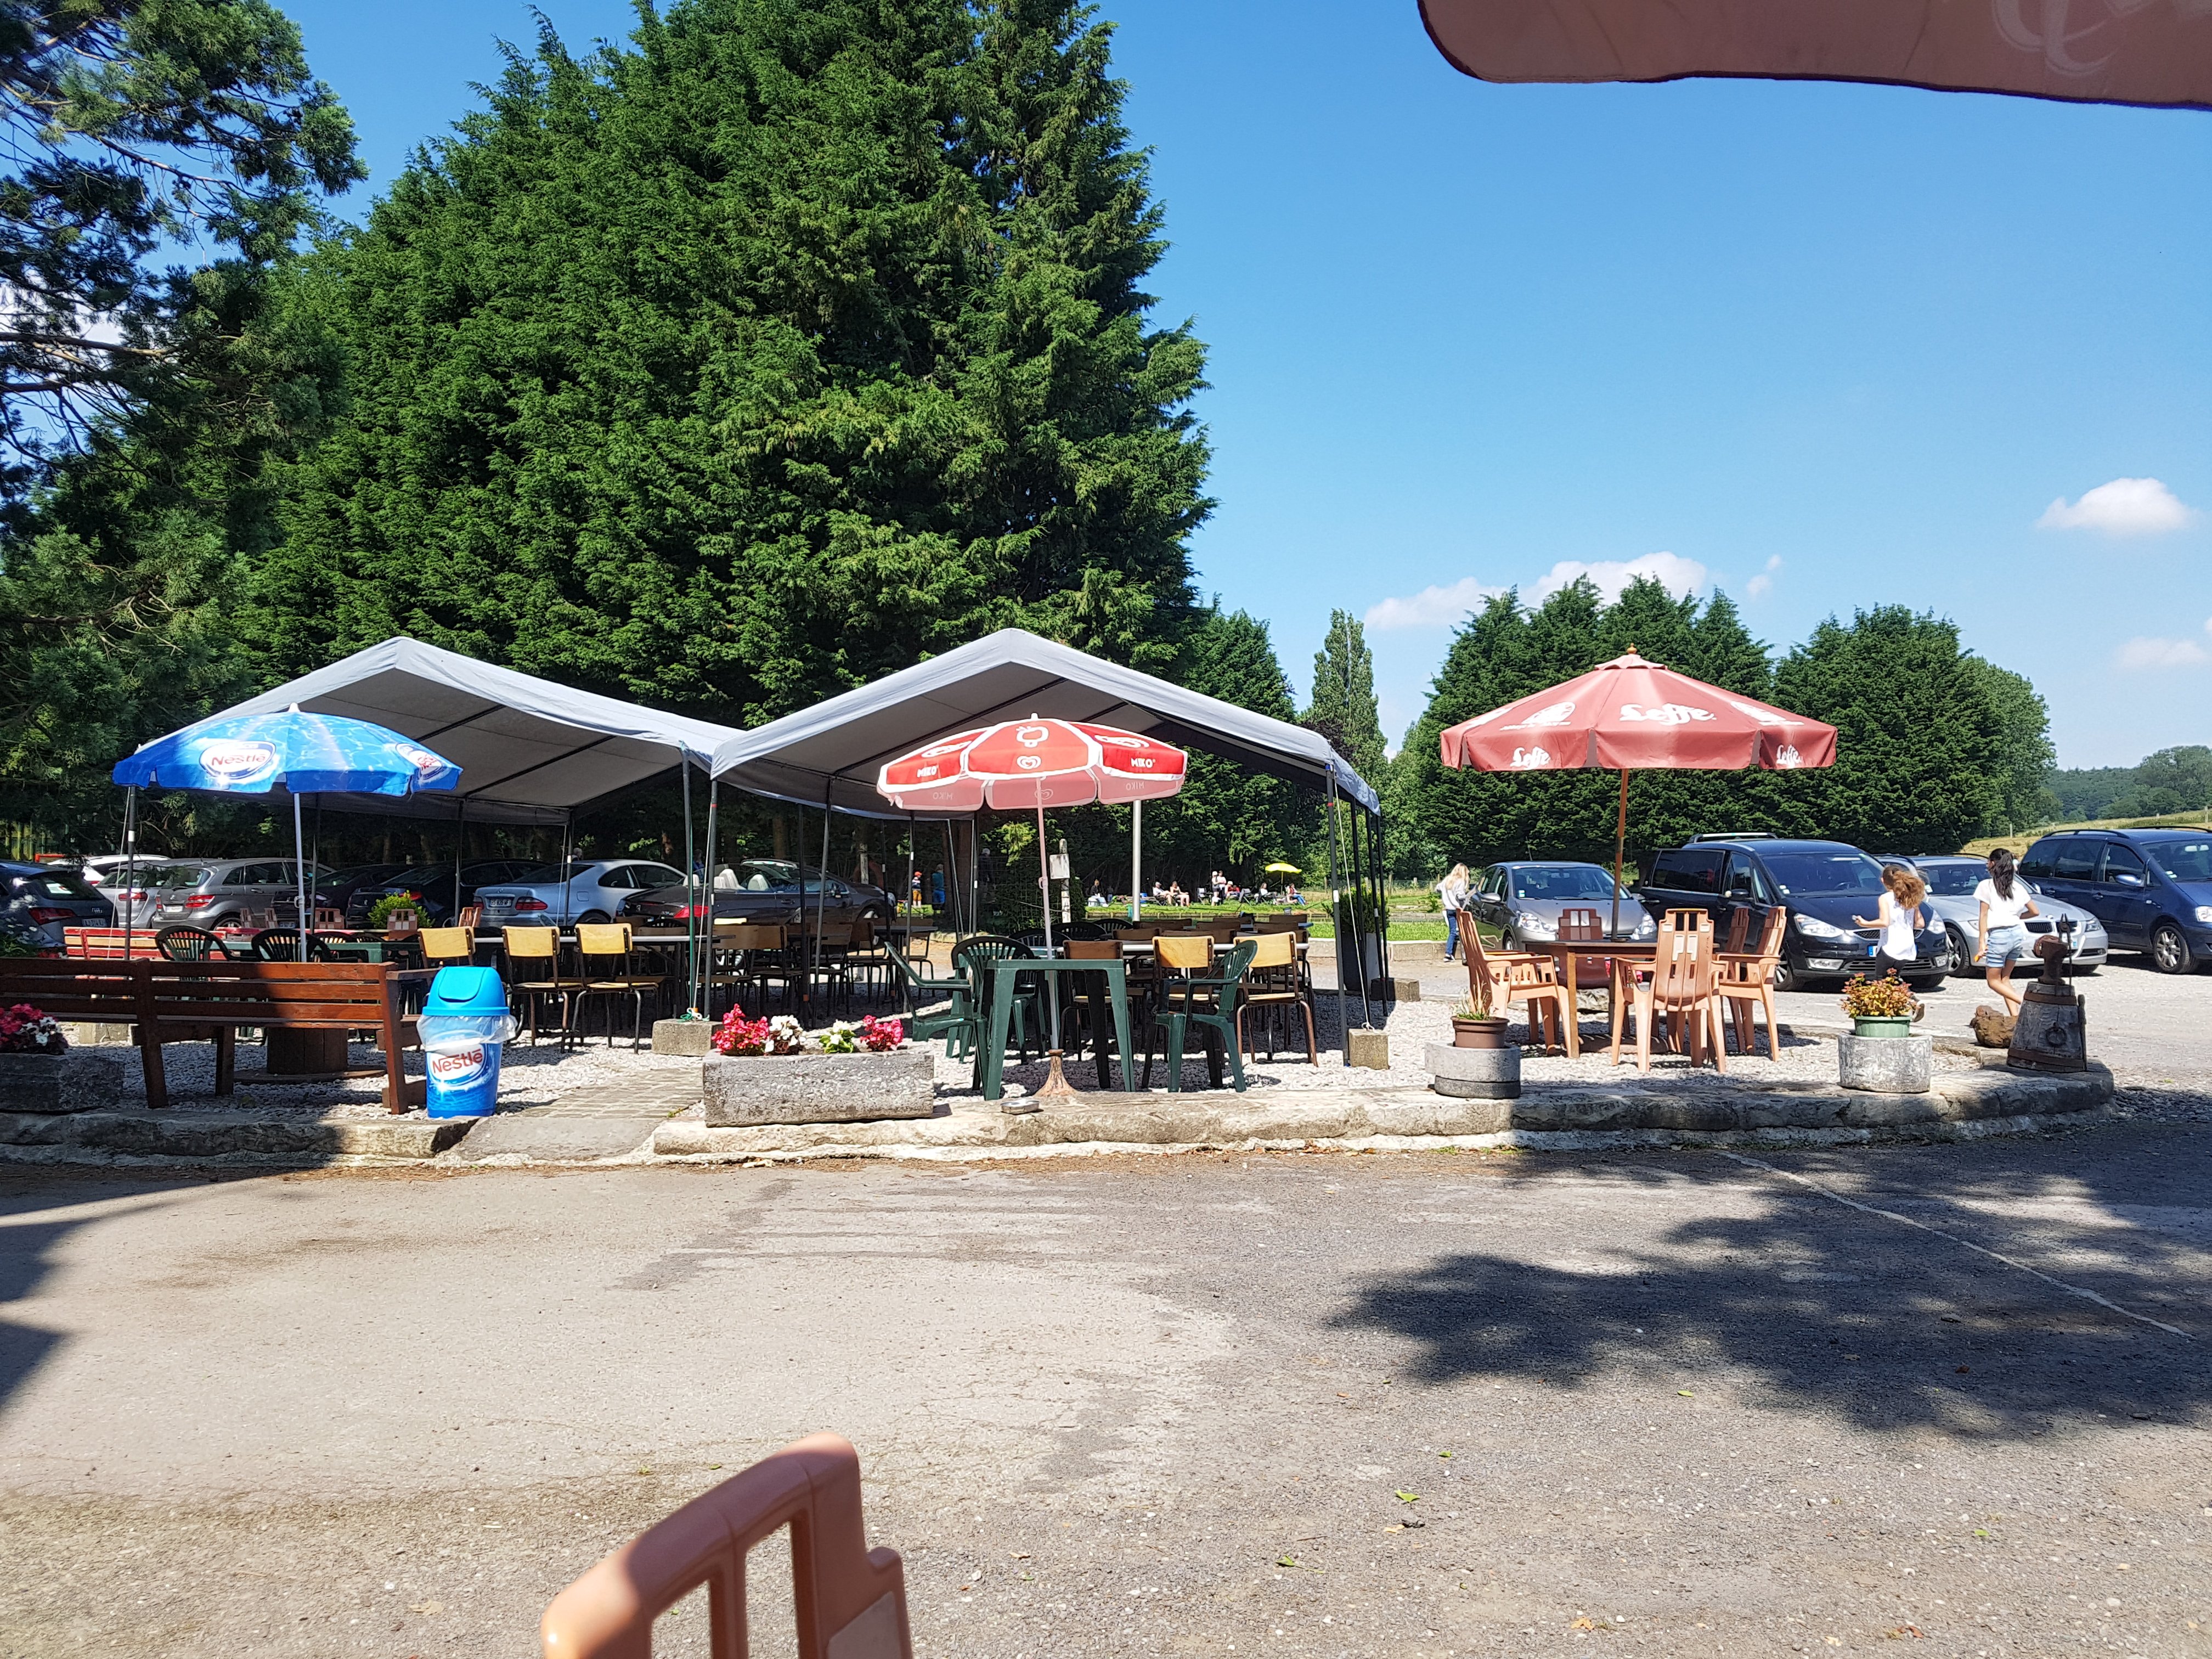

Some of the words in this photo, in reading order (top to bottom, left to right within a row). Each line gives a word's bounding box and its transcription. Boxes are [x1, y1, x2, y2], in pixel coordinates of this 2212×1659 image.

[1620, 703, 1715, 726] Leffe
[1131, 758, 1153, 768] MIKO
[1776, 743, 1801, 769] Leffe
[917, 765, 937, 777] MIKO
